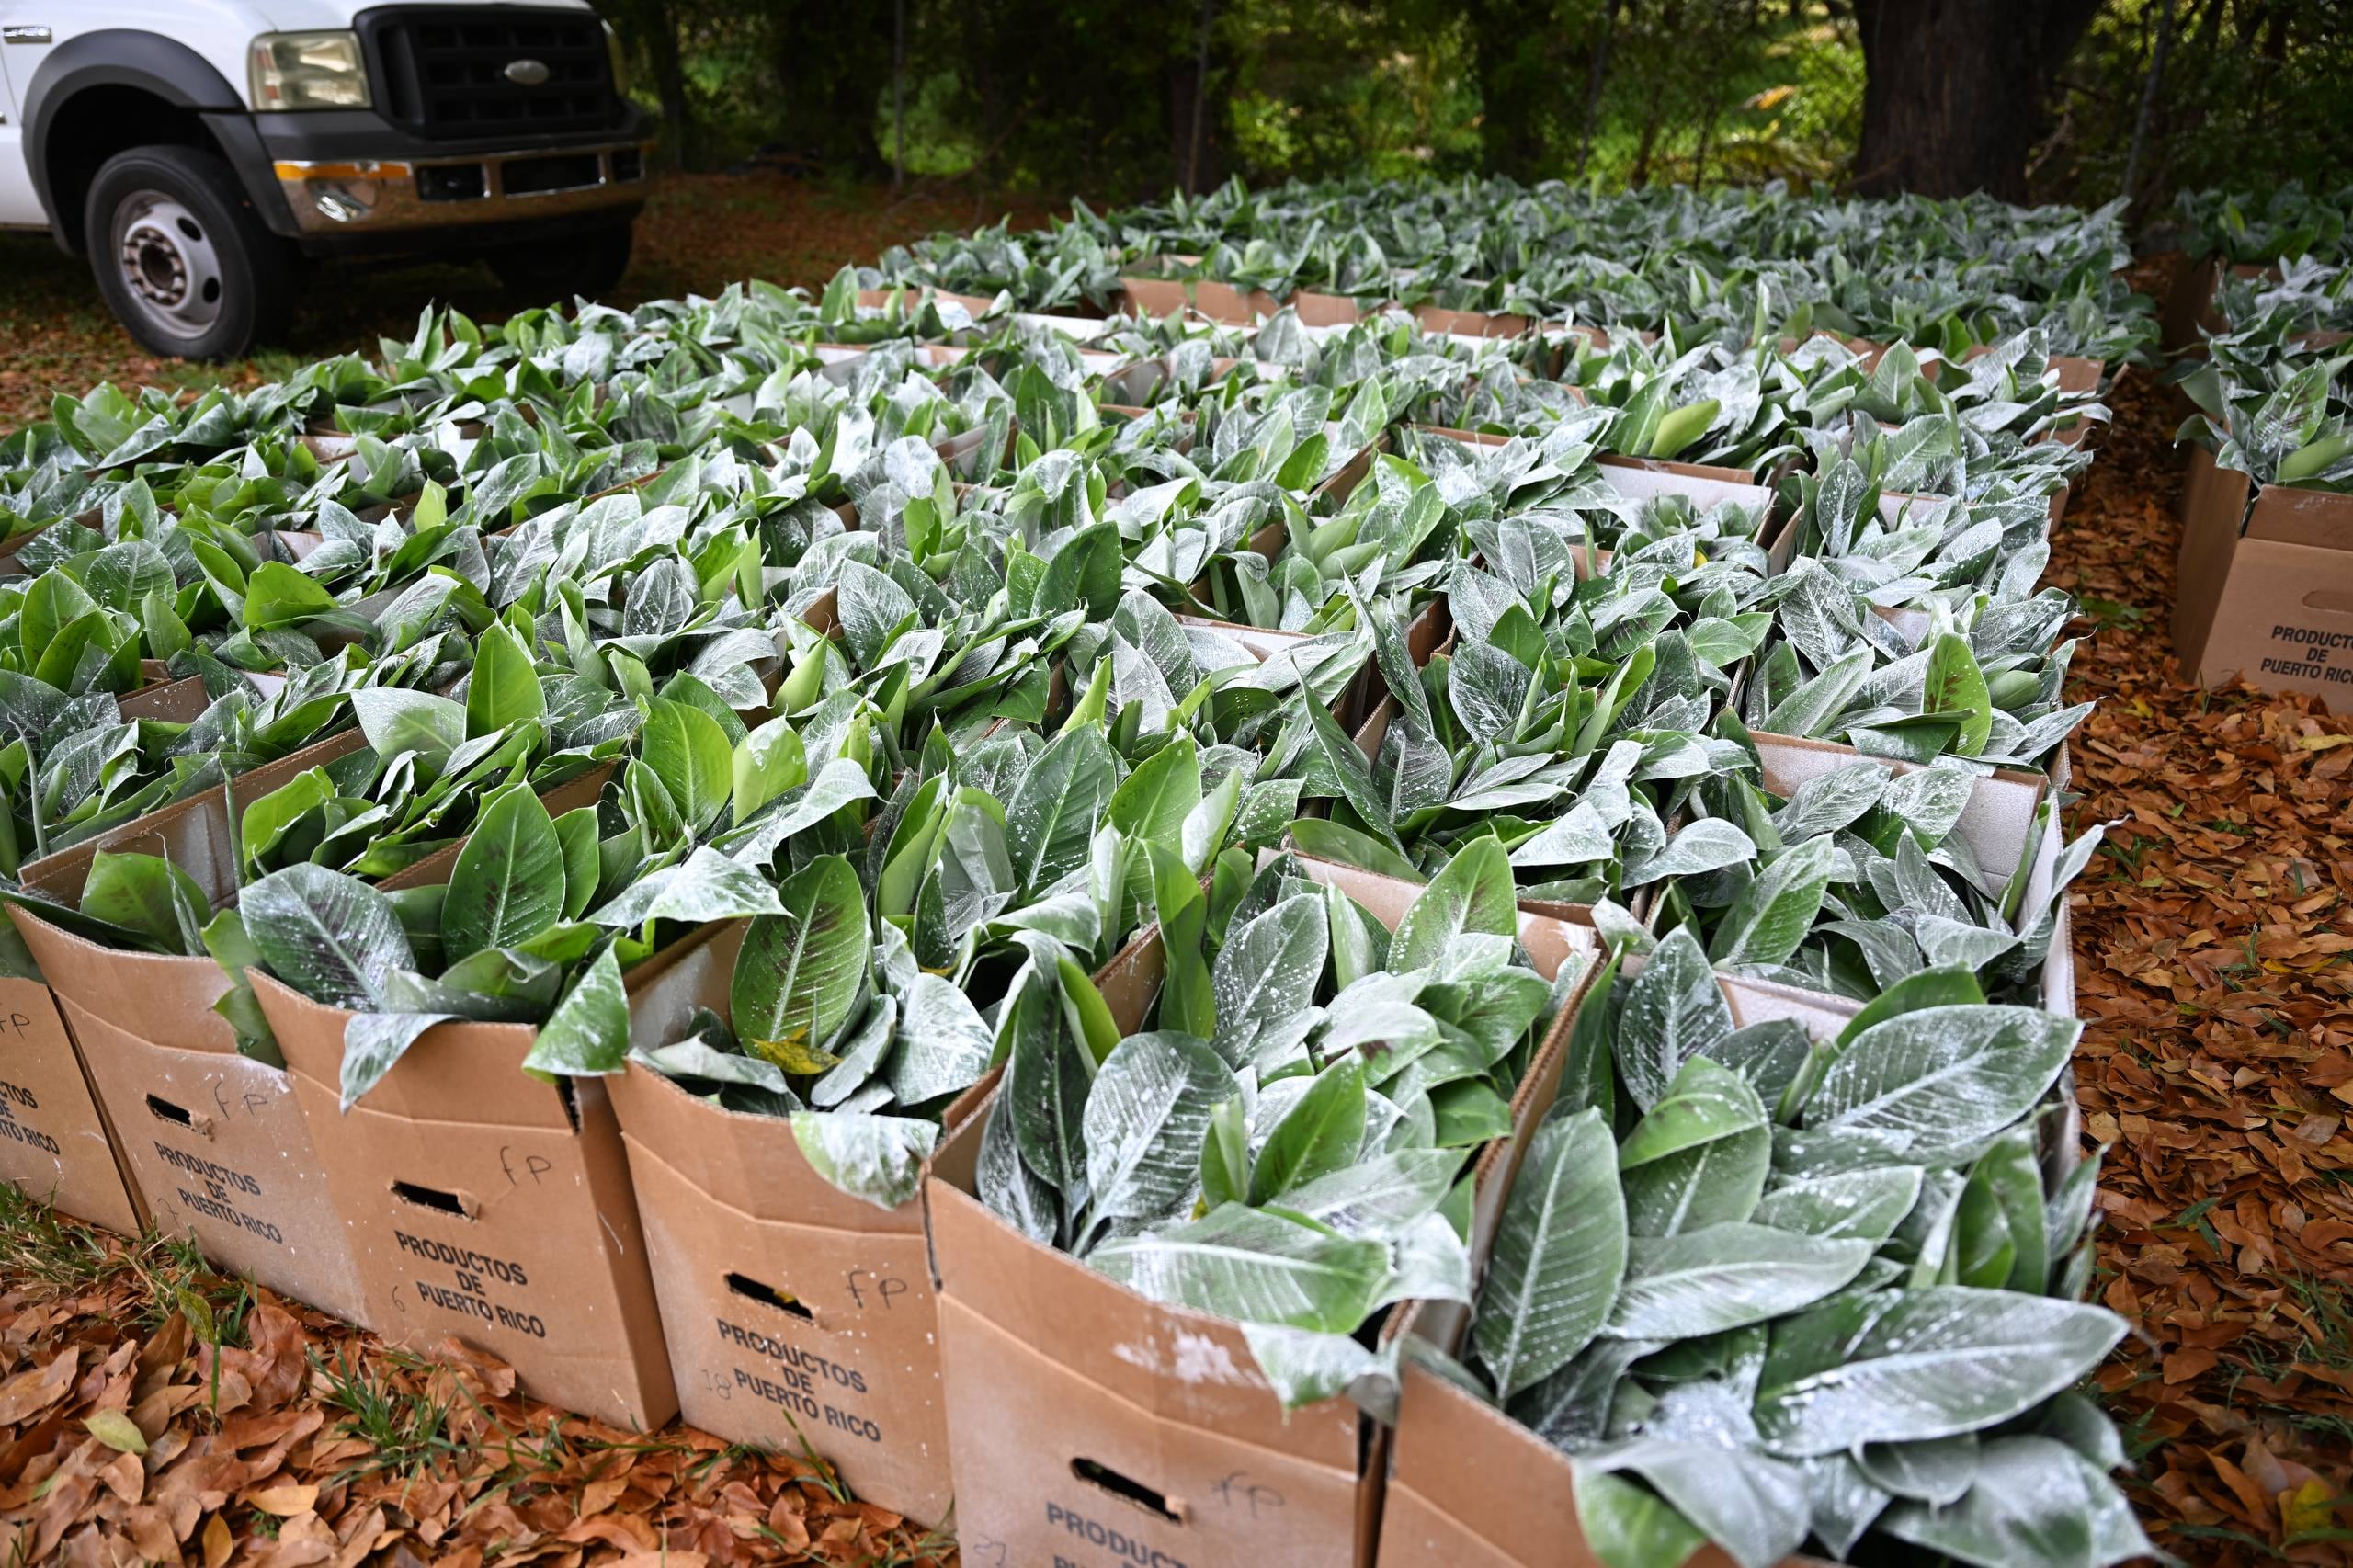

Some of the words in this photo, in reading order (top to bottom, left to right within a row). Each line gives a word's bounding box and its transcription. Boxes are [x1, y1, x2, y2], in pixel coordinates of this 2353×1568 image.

[2271, 625, 2353, 650] PRODUCT
[2306, 647, 2329, 663] DE
[2260, 658, 2322, 679] PUERTO
[2324, 666, 2353, 685] RIC
[23, 1126, 61, 1155] RICO
[153, 1141, 261, 1196] PRODUCTOS
[205, 1180, 233, 1204] DE
[176, 1187, 241, 1227] PUERTO
[240, 1212, 283, 1244] RICO
[393, 1230, 528, 1286] PRODUCTOS
[456, 1269, 486, 1296] DE
[392, 1286, 405, 1312] 6
[415, 1281, 494, 1322] PUERTO
[494, 1305, 546, 1338] RICO
[716, 1318, 867, 1393] PRODUCTOS
[782, 1367, 815, 1395] DE
[733, 1368, 819, 1420] PUERTO
[824, 1404, 881, 1443] RICO
